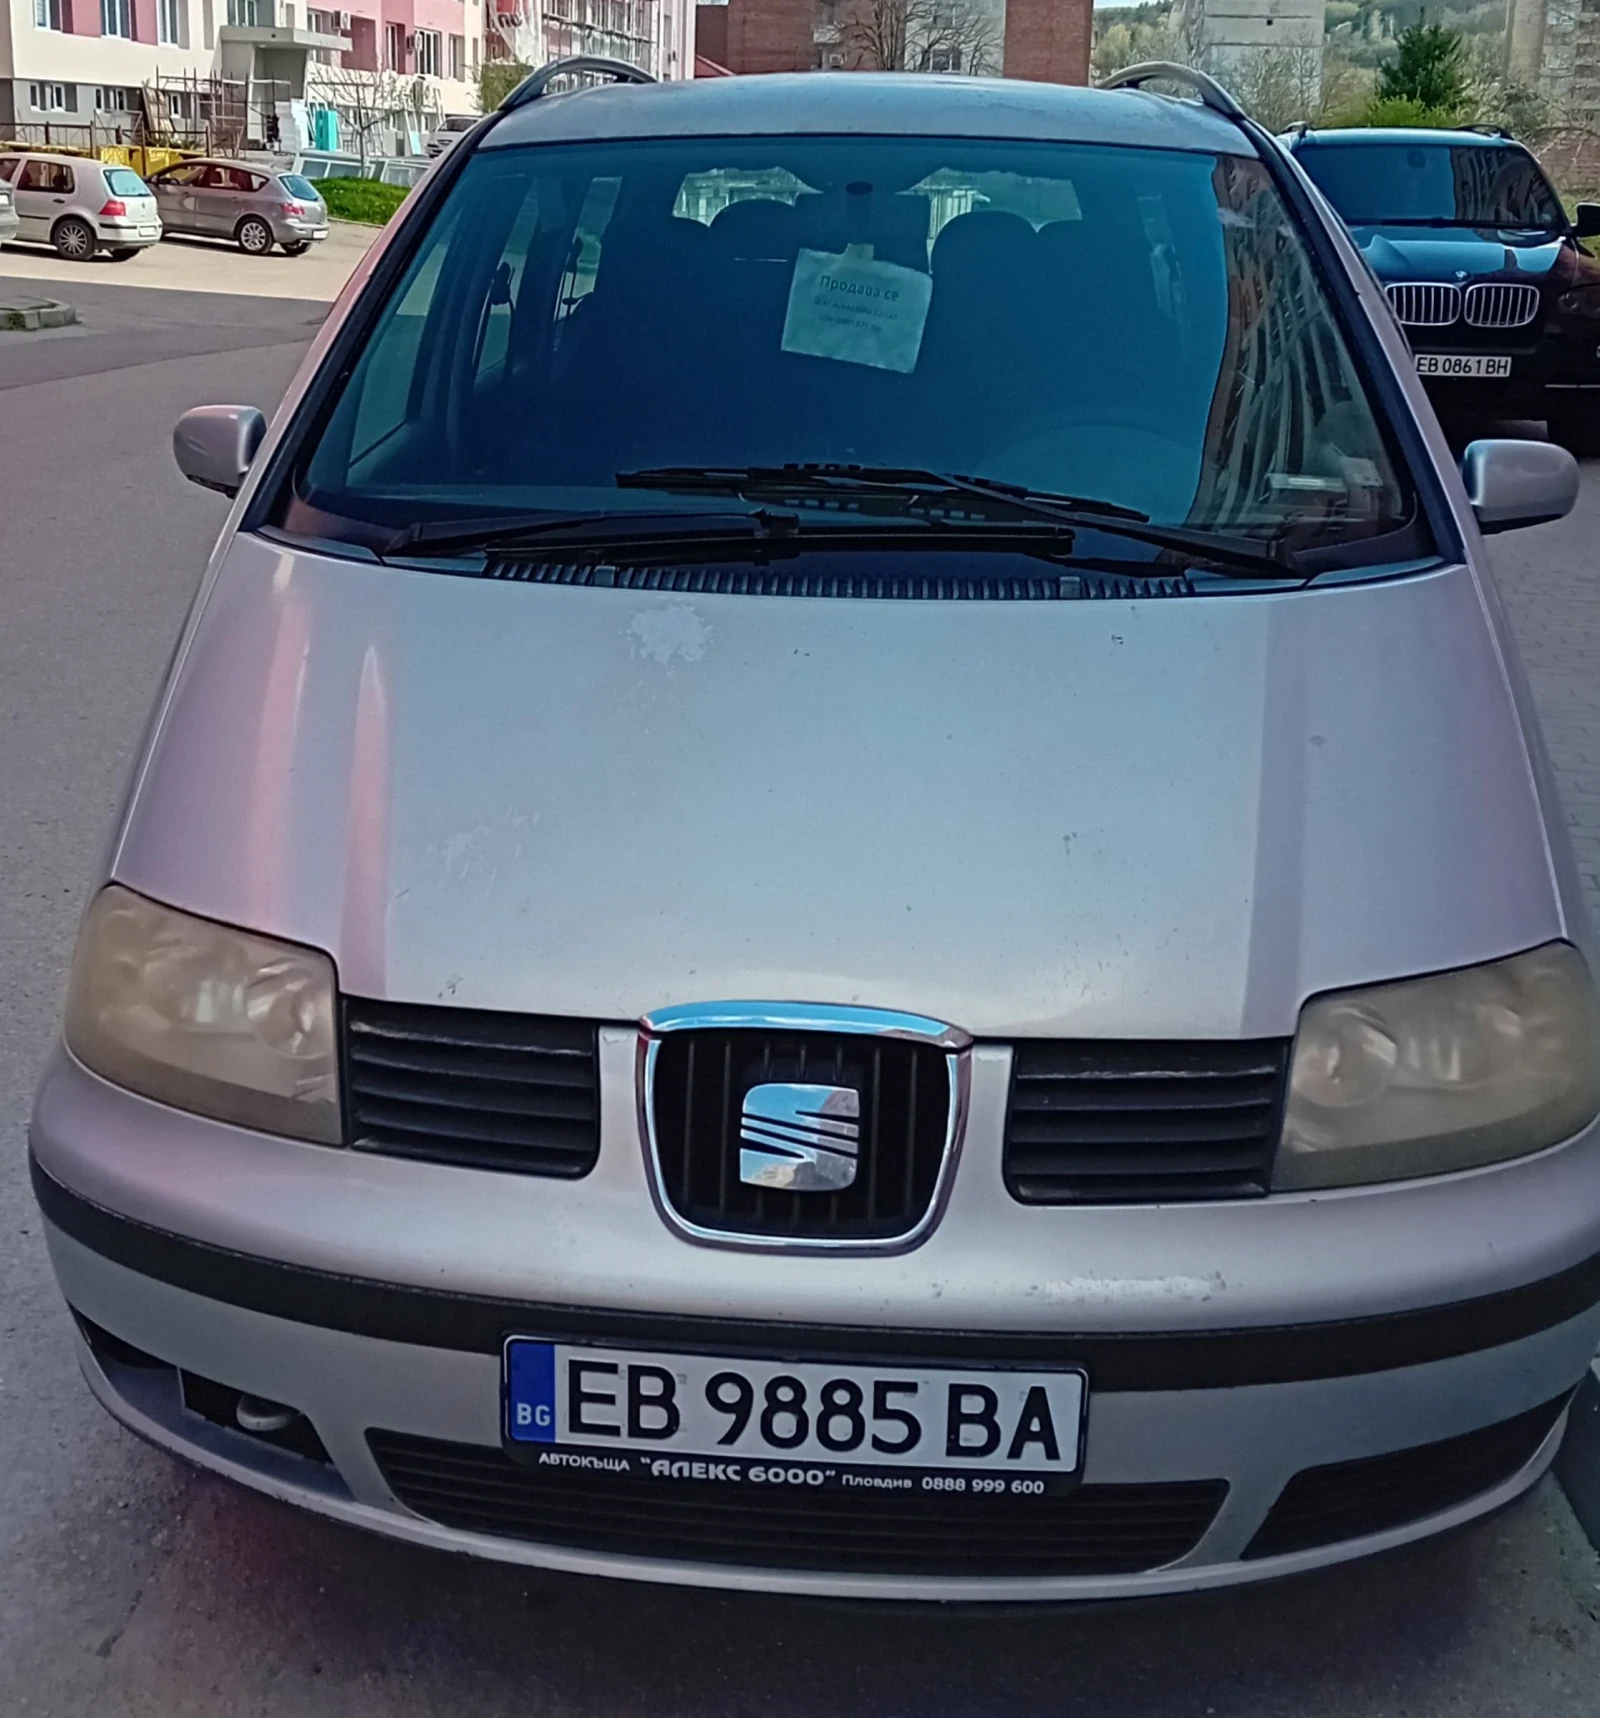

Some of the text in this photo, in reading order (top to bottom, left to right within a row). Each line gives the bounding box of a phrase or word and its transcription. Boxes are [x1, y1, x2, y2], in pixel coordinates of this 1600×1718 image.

[1417, 358, 1509, 375] EB 0861 BH
[516, 1402, 551, 1427] BG
[568, 1358, 1061, 1461] EB 9885 BA
[538, 1452, 631, 1472] АВТОКЪЩА
[841, 1474, 913, 1489] Пловдив
[921, 1476, 966, 1492] 0888
[971, 1479, 1006, 1494] 999
[1010, 1480, 1045, 1495] 600
